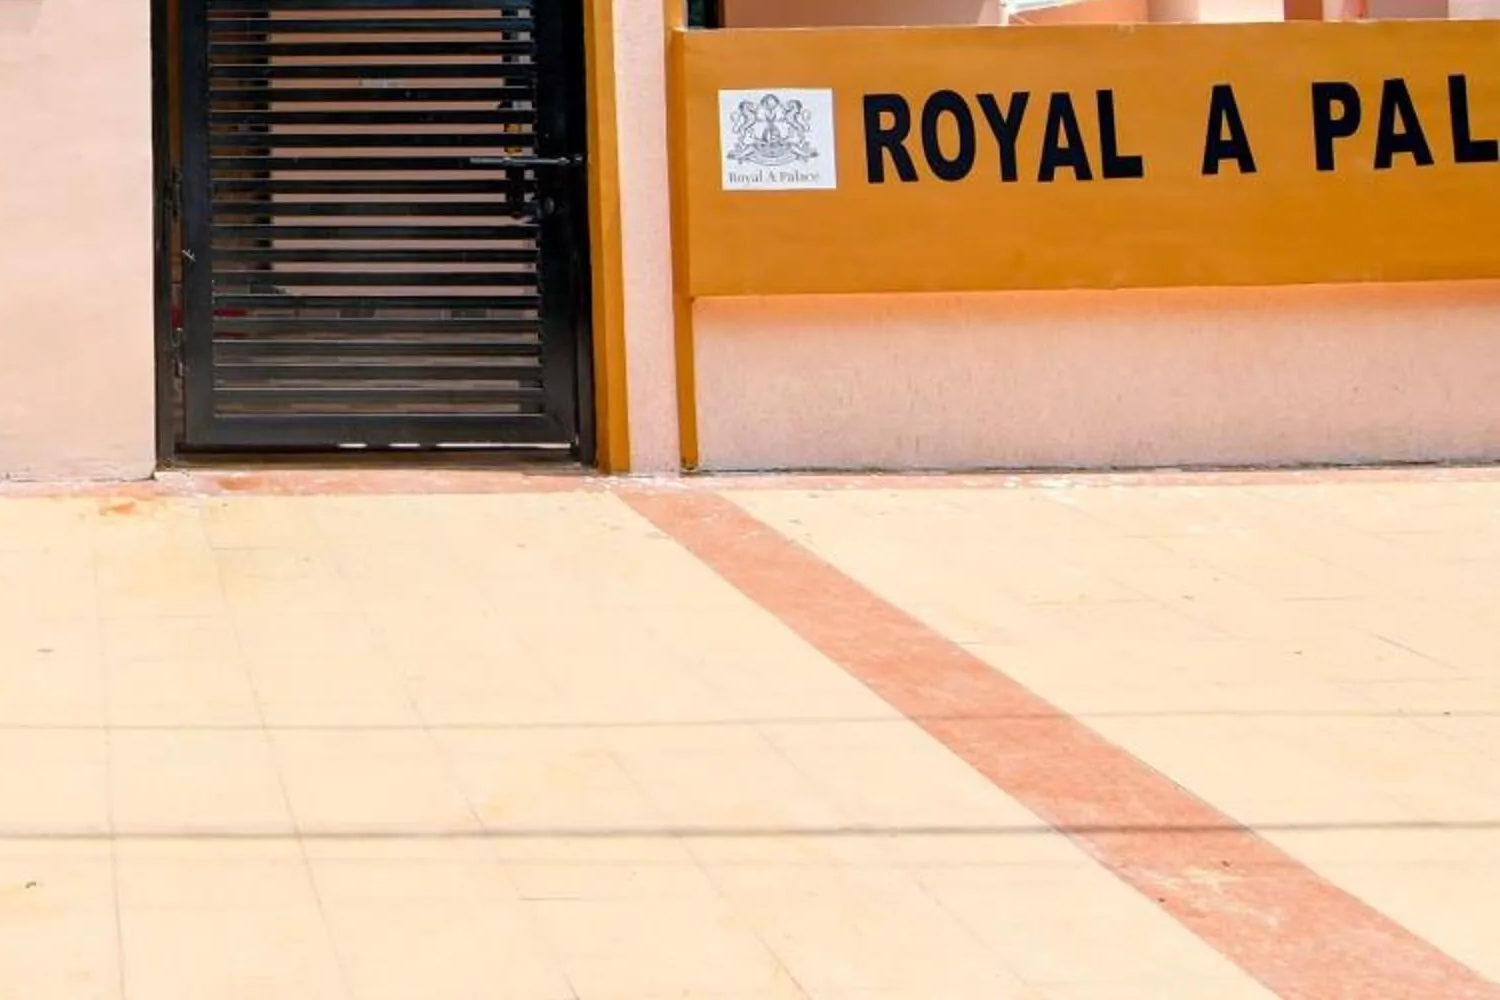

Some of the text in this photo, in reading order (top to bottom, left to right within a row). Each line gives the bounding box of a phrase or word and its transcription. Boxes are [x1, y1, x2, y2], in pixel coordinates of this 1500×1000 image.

[863, 74, 1499, 183] ROYAL A PAL
[728, 169, 763, 184] Royal
[767, 170, 776, 182] A
